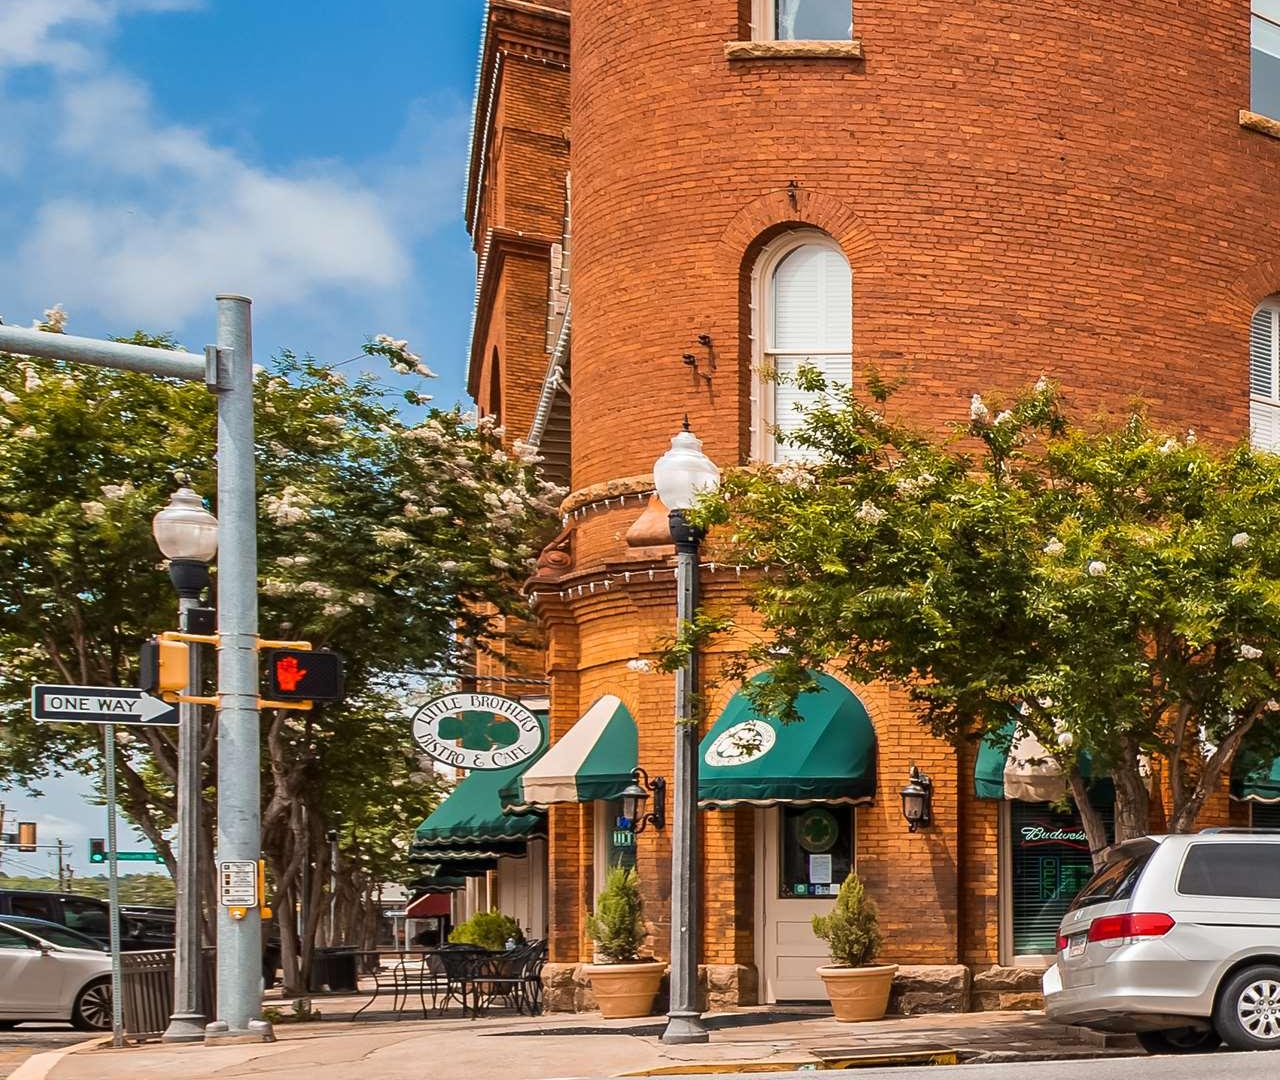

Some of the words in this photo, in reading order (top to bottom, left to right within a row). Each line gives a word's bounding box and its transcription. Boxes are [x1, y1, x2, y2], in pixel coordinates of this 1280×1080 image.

[50, 697, 90, 710] ONE
[97, 699, 137, 713] WAY
[417, 697, 463, 726] LITTLE
[417, 733, 466, 765] BISTRO
[472, 754, 485, 767] &
[1021, 827, 1089, 841] Budweis
